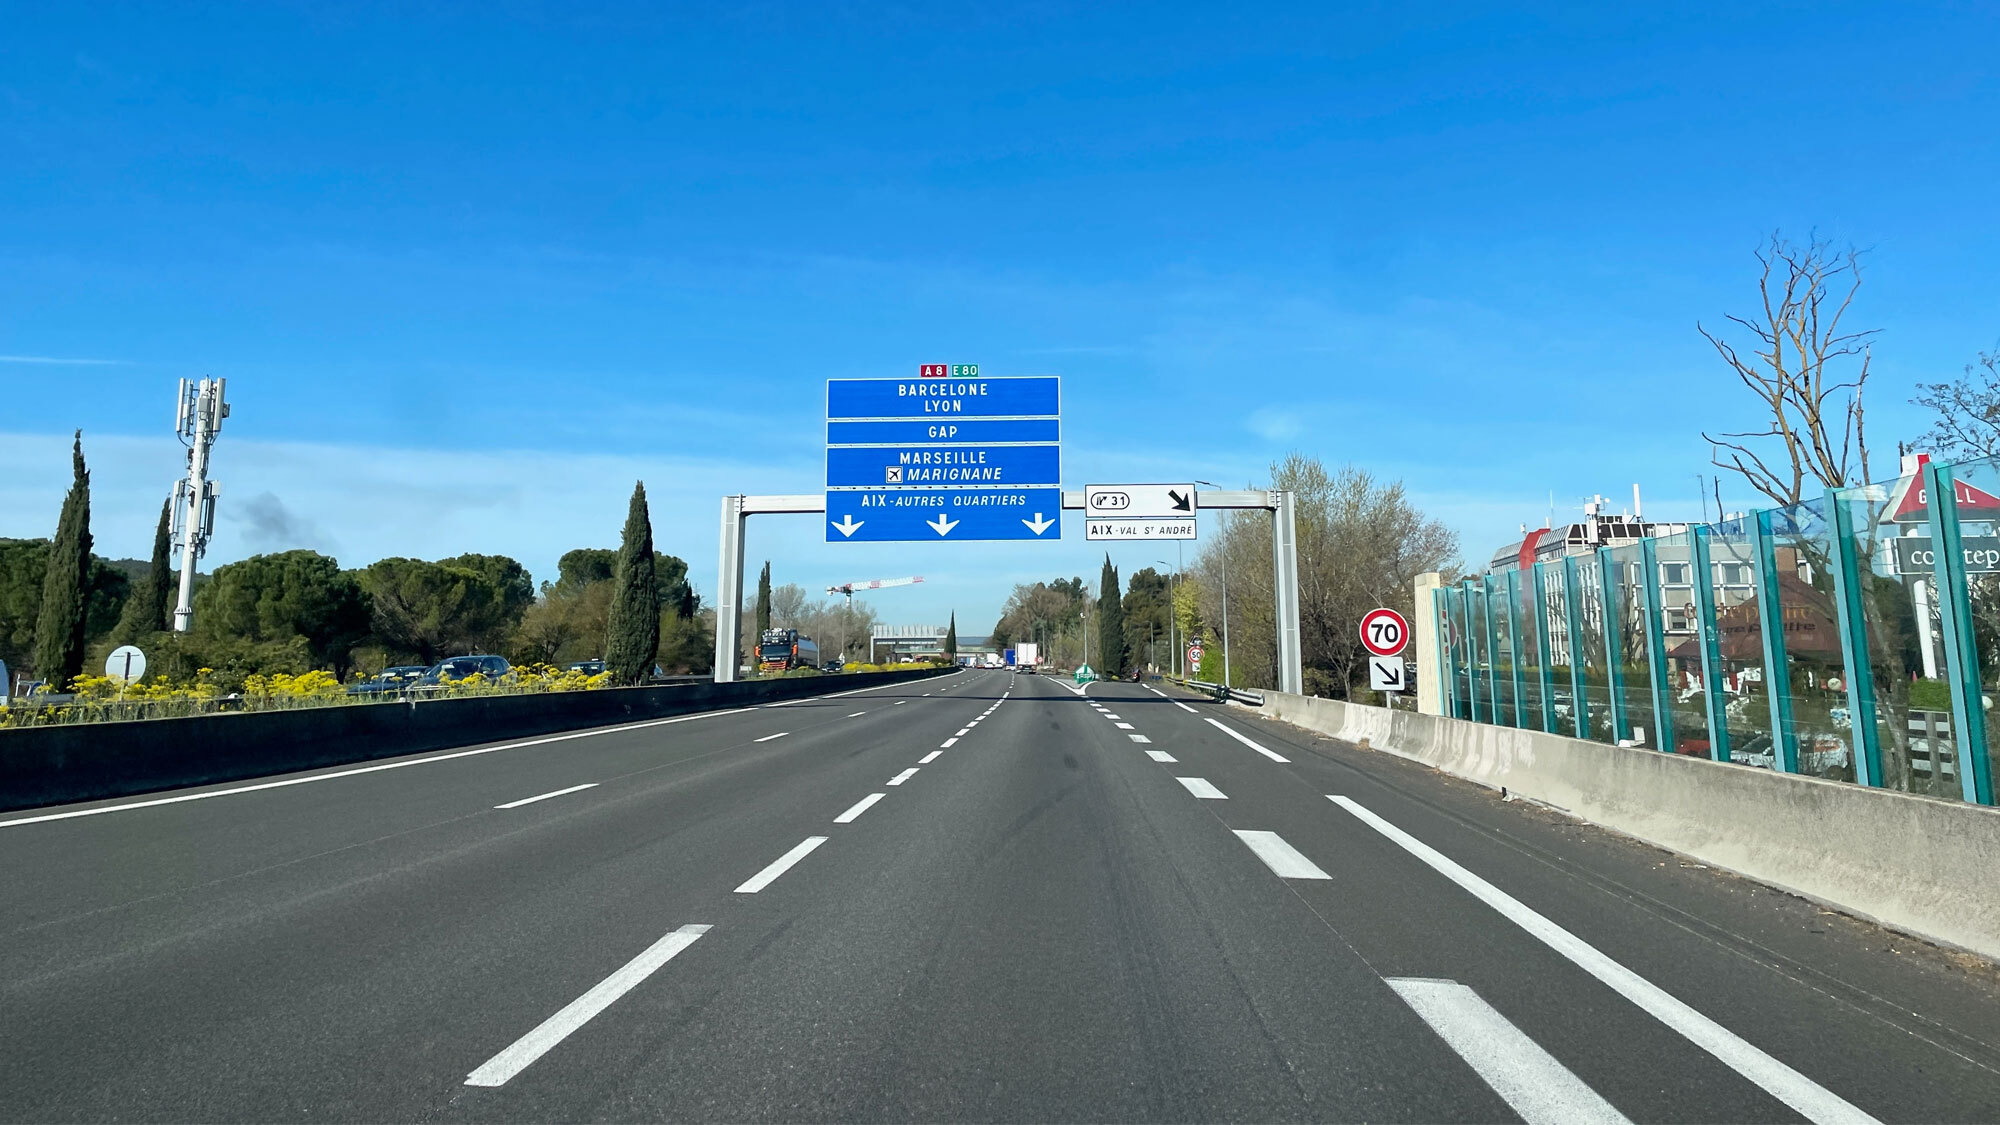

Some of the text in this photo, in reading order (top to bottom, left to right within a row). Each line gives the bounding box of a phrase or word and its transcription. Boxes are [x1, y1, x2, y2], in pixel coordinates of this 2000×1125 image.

[898, 383, 988, 396] BARCELONE
[925, 400, 961, 412] LYON
[928, 425, 958, 438] GAP
[900, 451, 986, 464] MARSEILLE
[907, 467, 1002, 481] MARIGNANE
[953, 495, 1026, 506] QUARTIERS
[1111, 496, 1125, 506] 31
[1918, 488, 1976, 504] GLL
[1159, 524, 1192, 535] ANDRÉ
[1911, 548, 2000, 569] cotep
[1371, 624, 1399, 643] 70
[1191, 651, 1201, 659] 50
